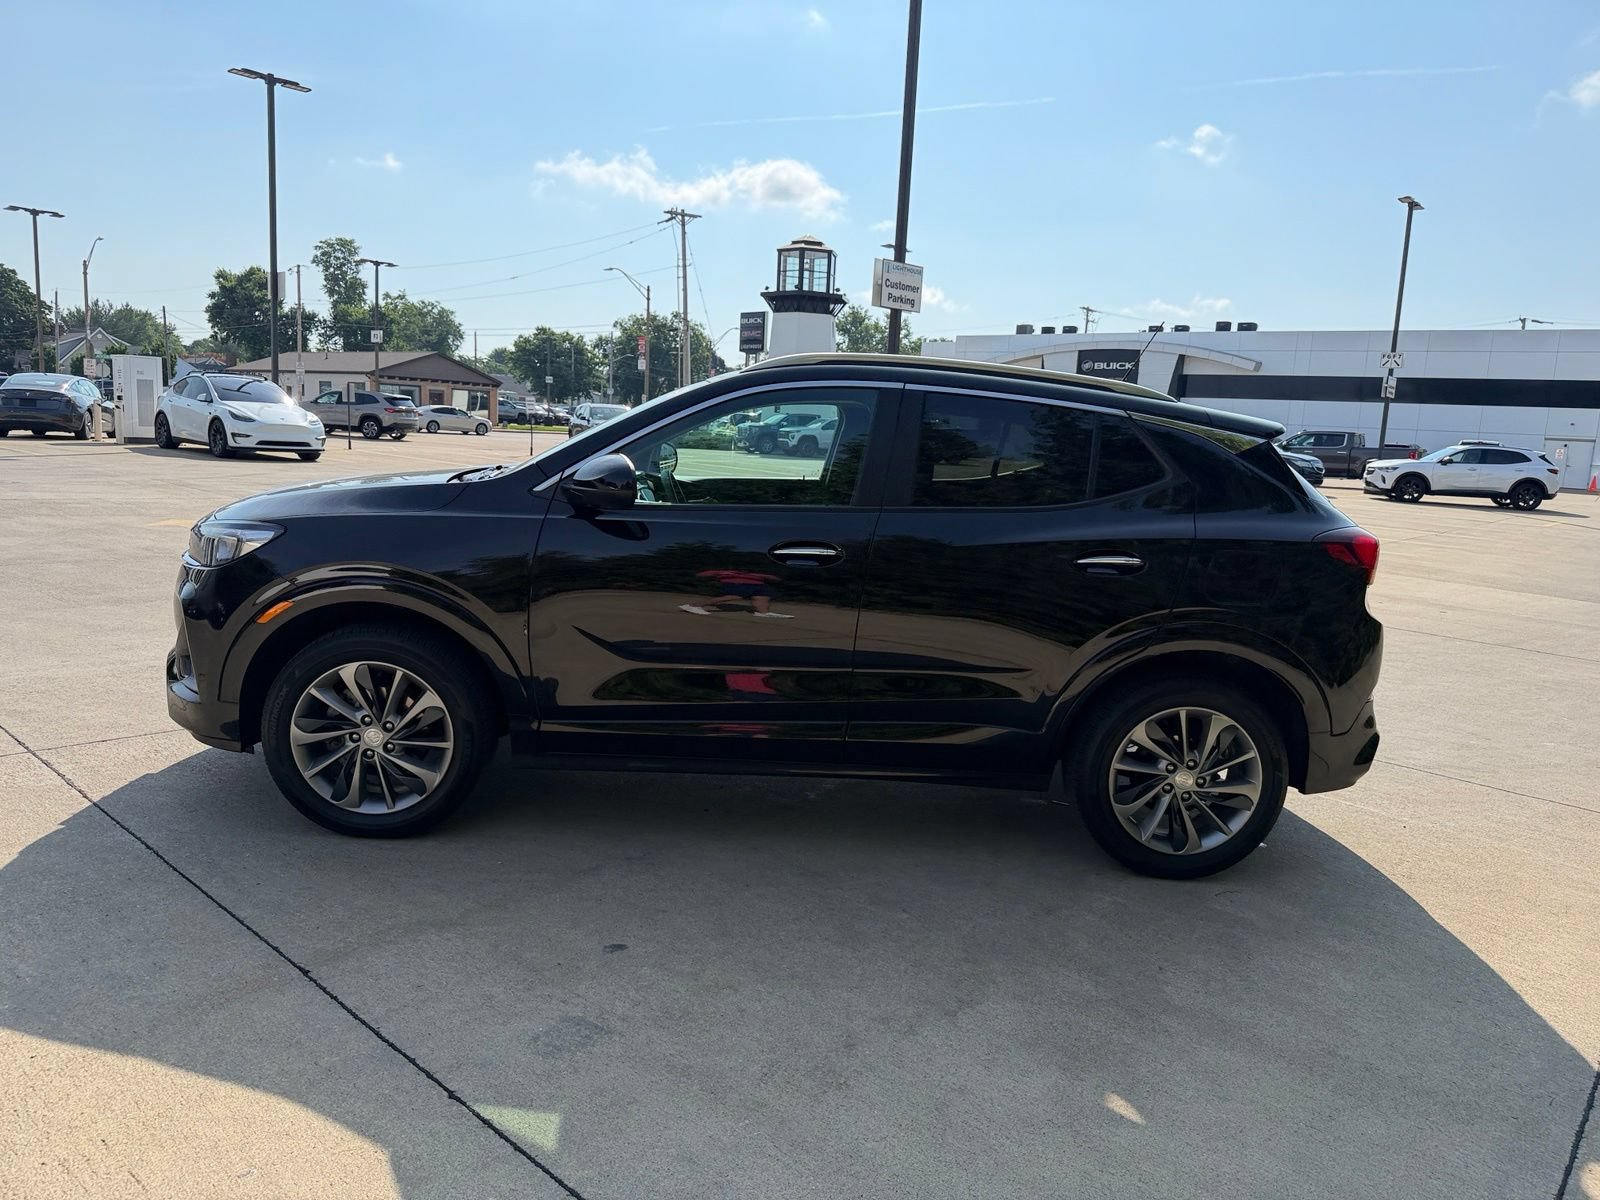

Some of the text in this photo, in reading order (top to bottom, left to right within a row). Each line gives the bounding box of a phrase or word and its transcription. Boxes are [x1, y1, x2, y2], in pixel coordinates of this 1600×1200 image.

[885, 278, 920, 294] Customer
[887, 292, 915, 308] Parking
[1094, 361, 1136, 370] BUICK
